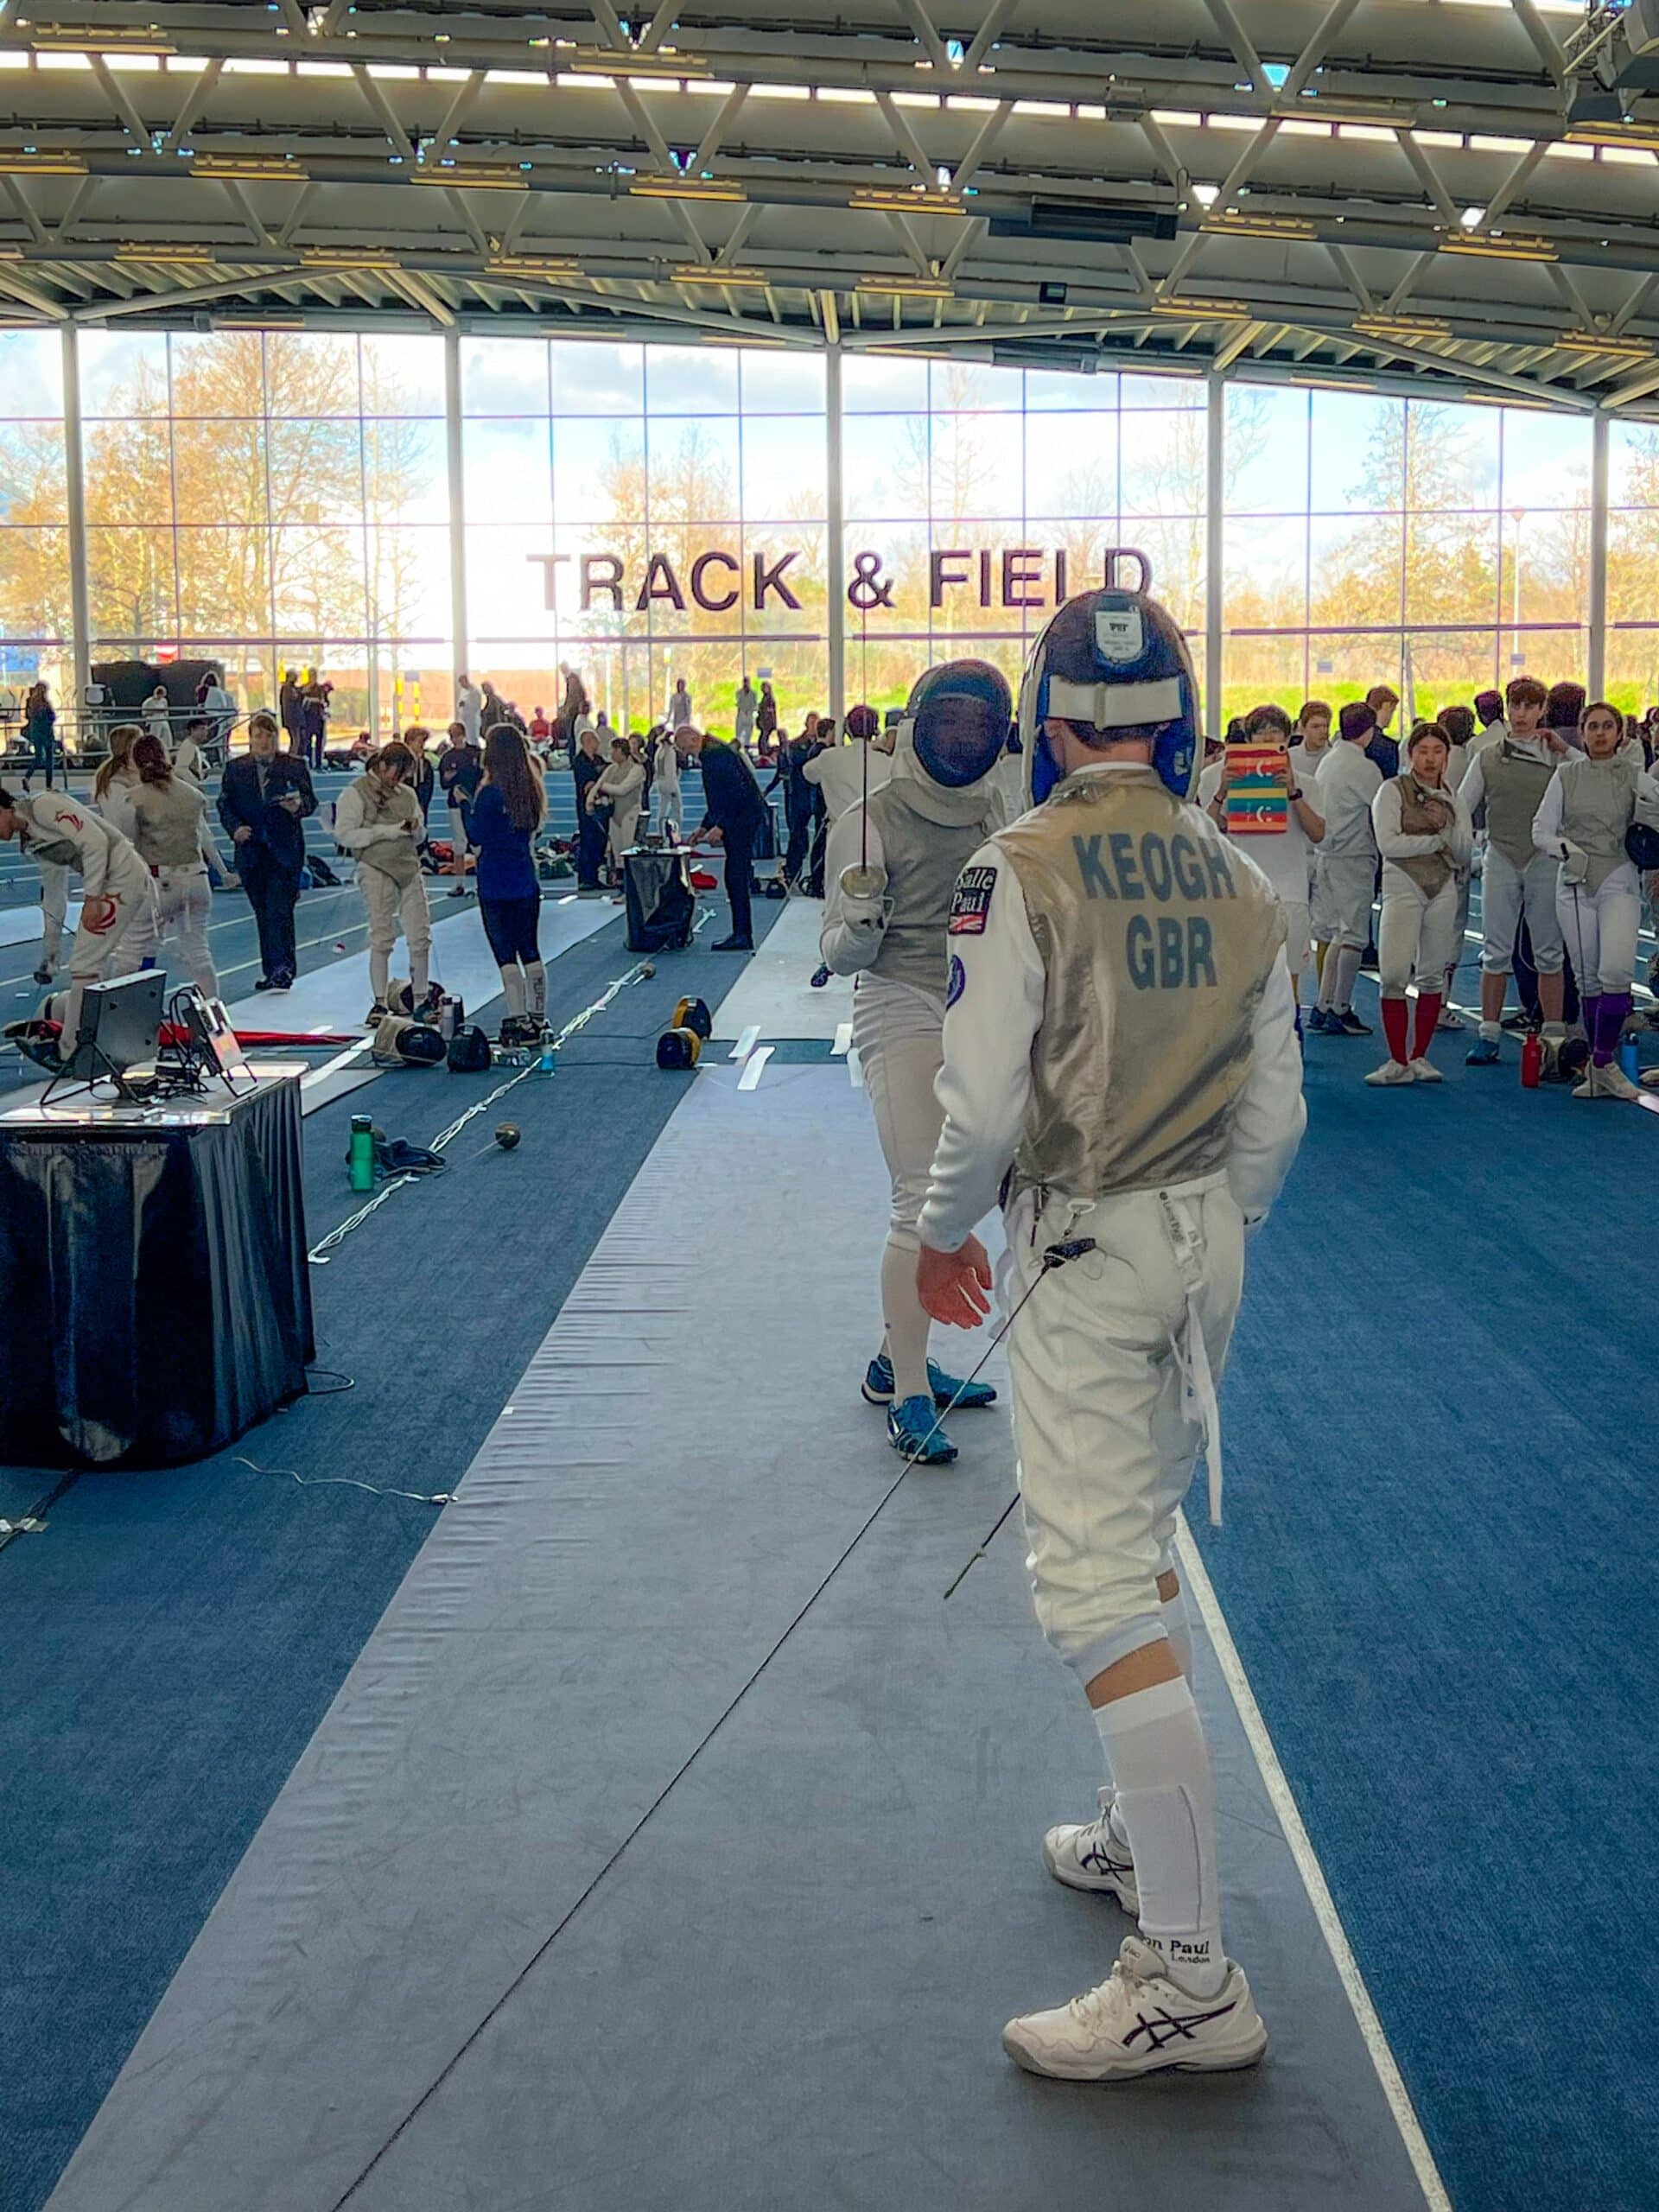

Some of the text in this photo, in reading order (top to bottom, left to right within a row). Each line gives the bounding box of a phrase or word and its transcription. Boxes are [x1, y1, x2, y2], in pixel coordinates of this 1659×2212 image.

[525, 551, 804, 612] TRACK
[847, 550, 896, 610] &
[1071, 832, 1238, 902] KEOGH
[951, 891, 985, 913] Paul
[1126, 913, 1218, 991] GBR
[1171, 1939, 1210, 1955] Paul
